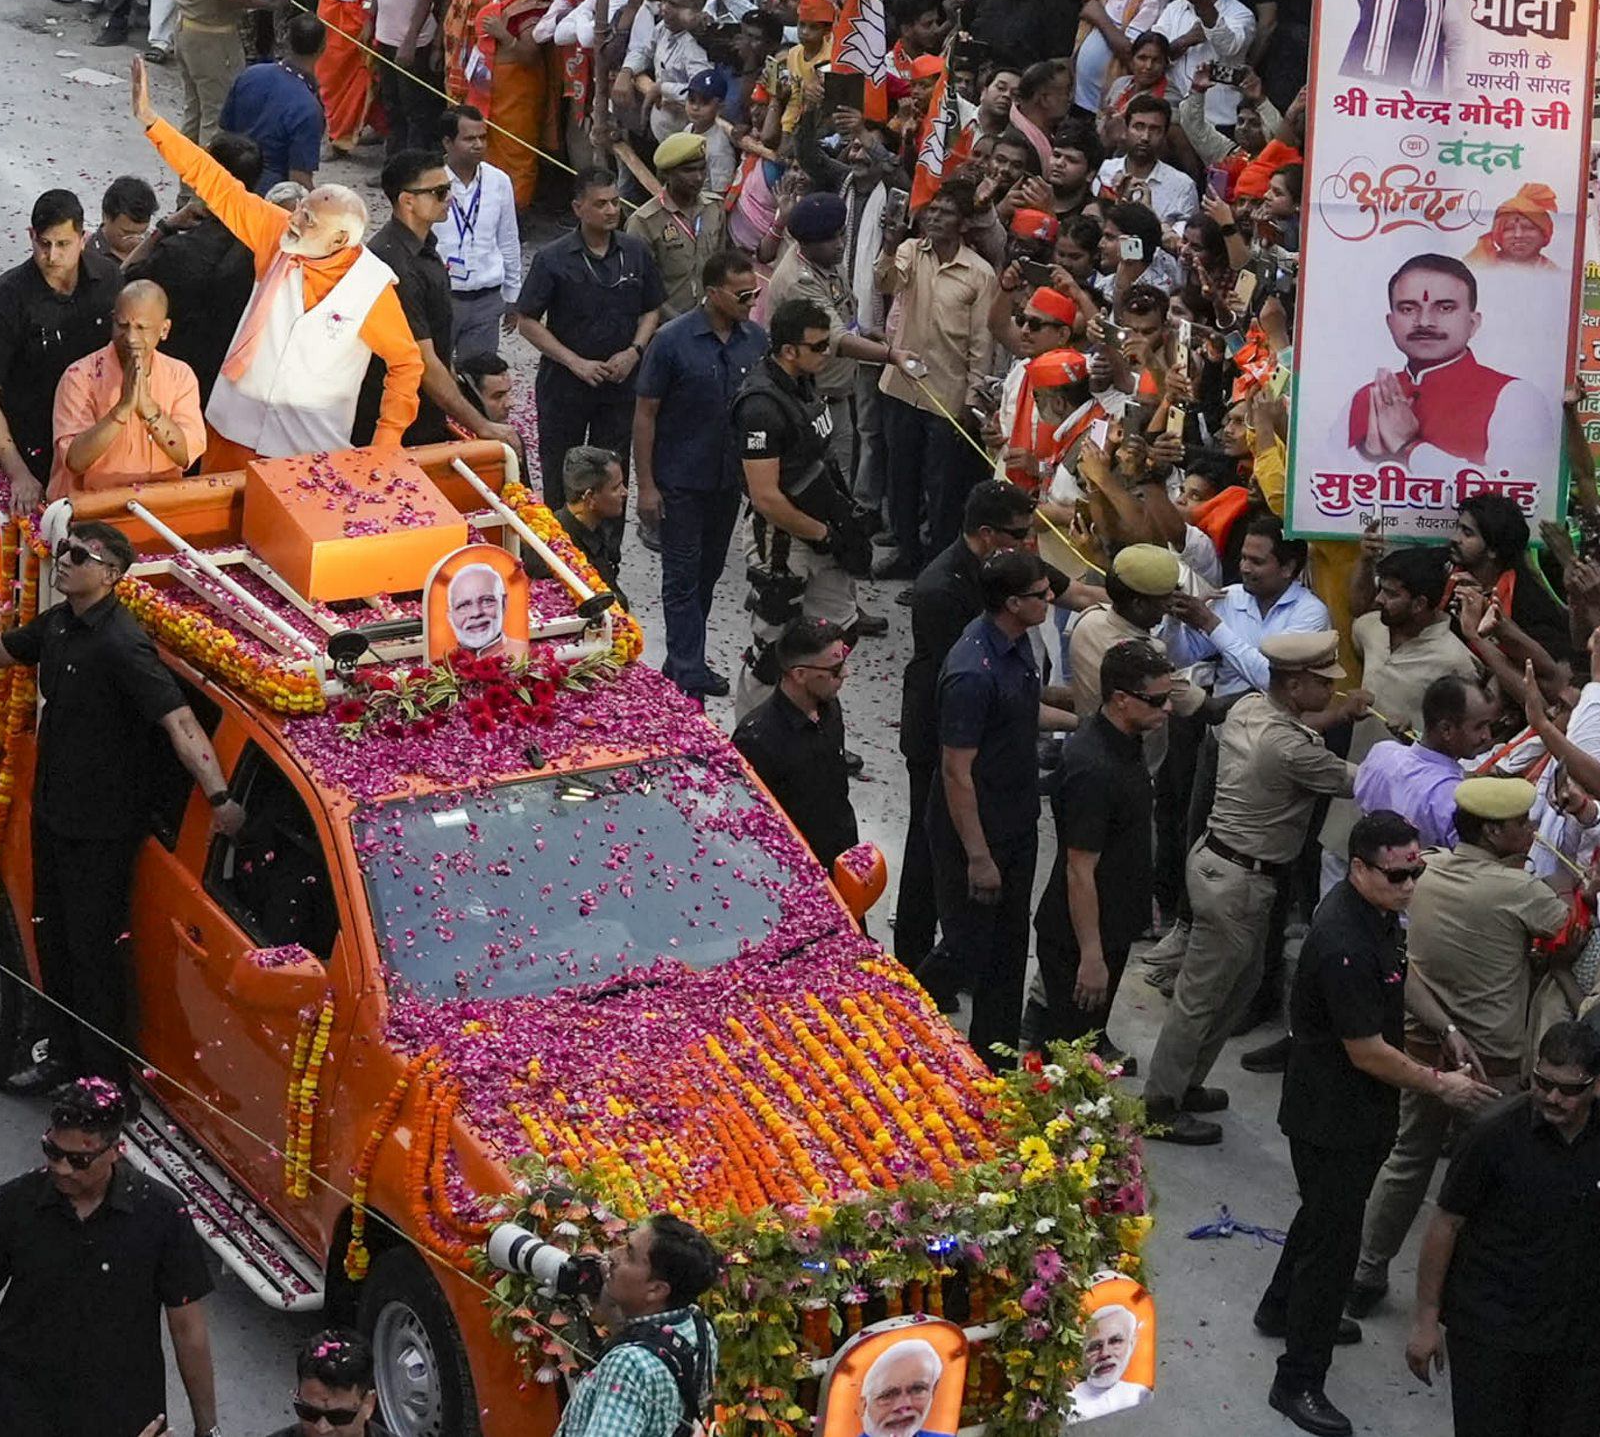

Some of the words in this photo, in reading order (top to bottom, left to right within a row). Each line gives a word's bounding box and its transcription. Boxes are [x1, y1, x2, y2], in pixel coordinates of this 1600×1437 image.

[1488, 48, 1530, 70] काशी
[1536, 50, 1553, 71] के
[1466, 71, 1520, 93] यशस्वी
[1526, 75, 1572, 96] सांसद
[1333, 87, 1369, 117] श्री
[1375, 89, 1452, 126] नरेन्द्र
[1458, 94, 1525, 129] मोदी
[1532, 100, 1571, 131] जी
[1407, 140, 1423, 152] का
[1437, 130, 1525, 175] वंदन
[1335, 159, 1475, 234] अभिनंदन
[1311, 463, 1447, 512] सुशील
[1414, 515, 1461, 532] सैयदराज
